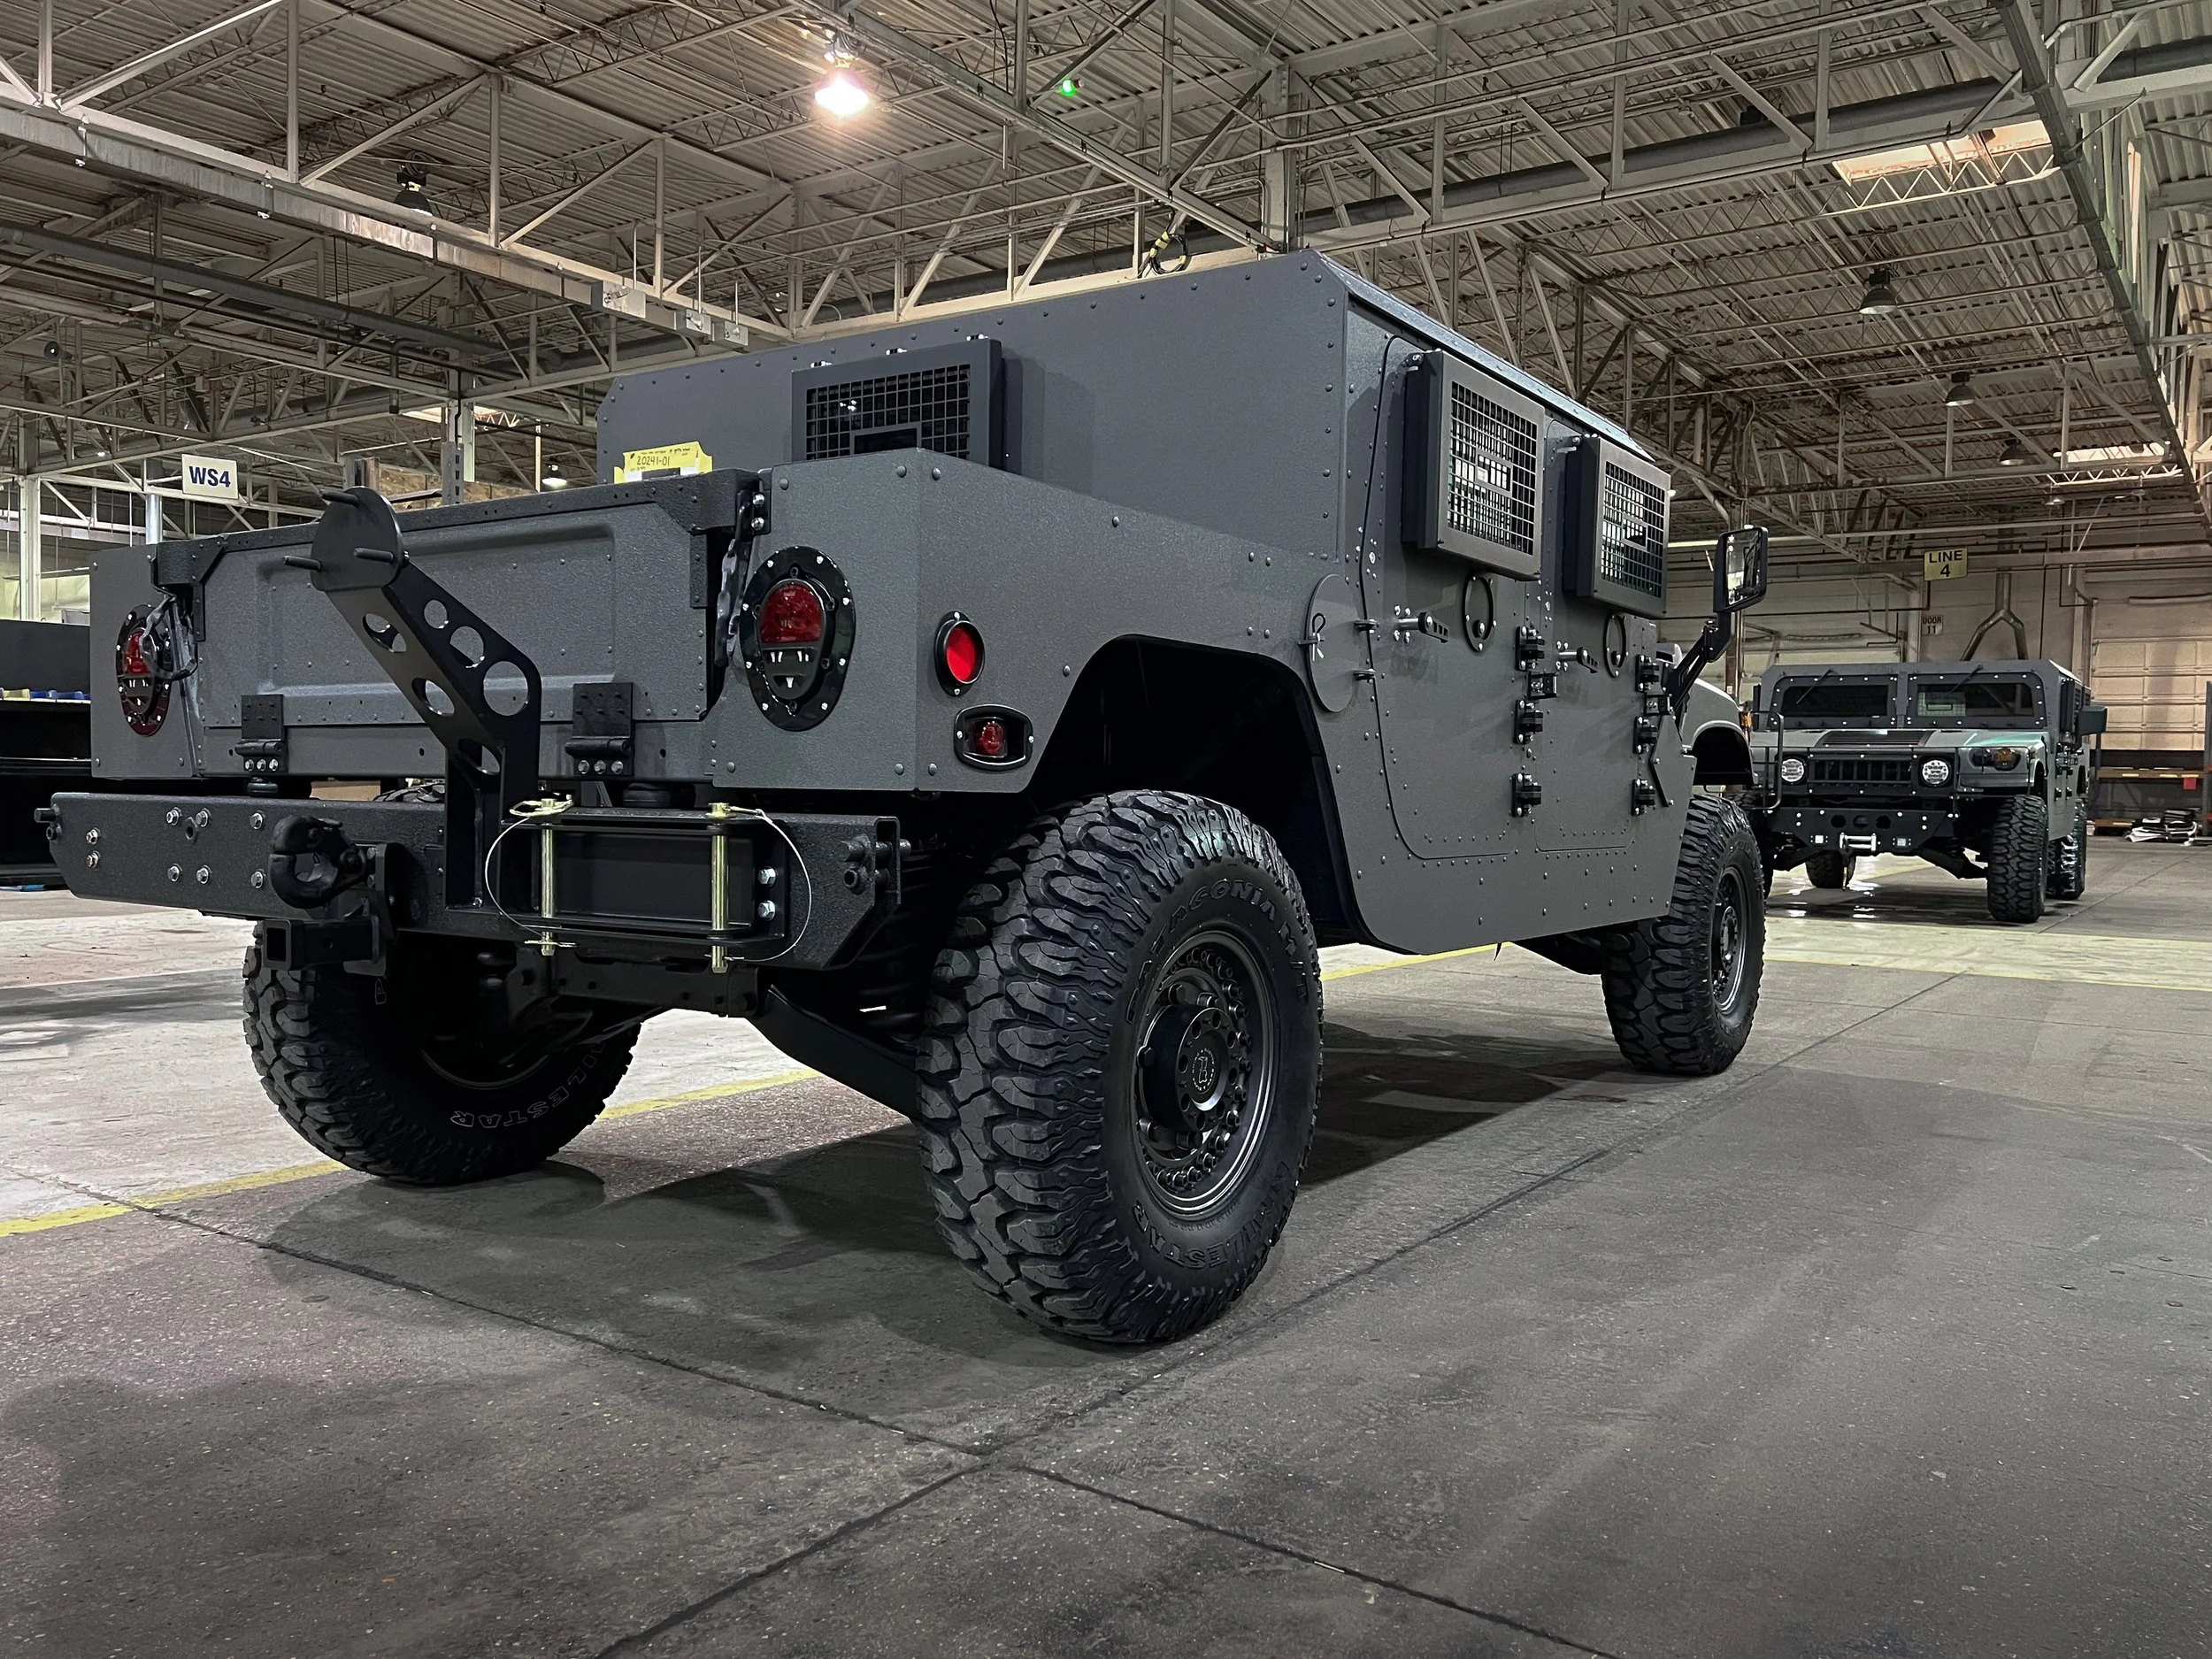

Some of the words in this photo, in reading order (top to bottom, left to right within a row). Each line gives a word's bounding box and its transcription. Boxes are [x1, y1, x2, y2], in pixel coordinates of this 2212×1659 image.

[636, 456, 670, 466] 20241-01
[188, 465, 231, 488] WS4
[1929, 549, 1962, 564] LINE
[1939, 564, 1951, 577] 4
[1922, 616, 1942, 625] DOOR
[1927, 625, 1936, 634] 11
